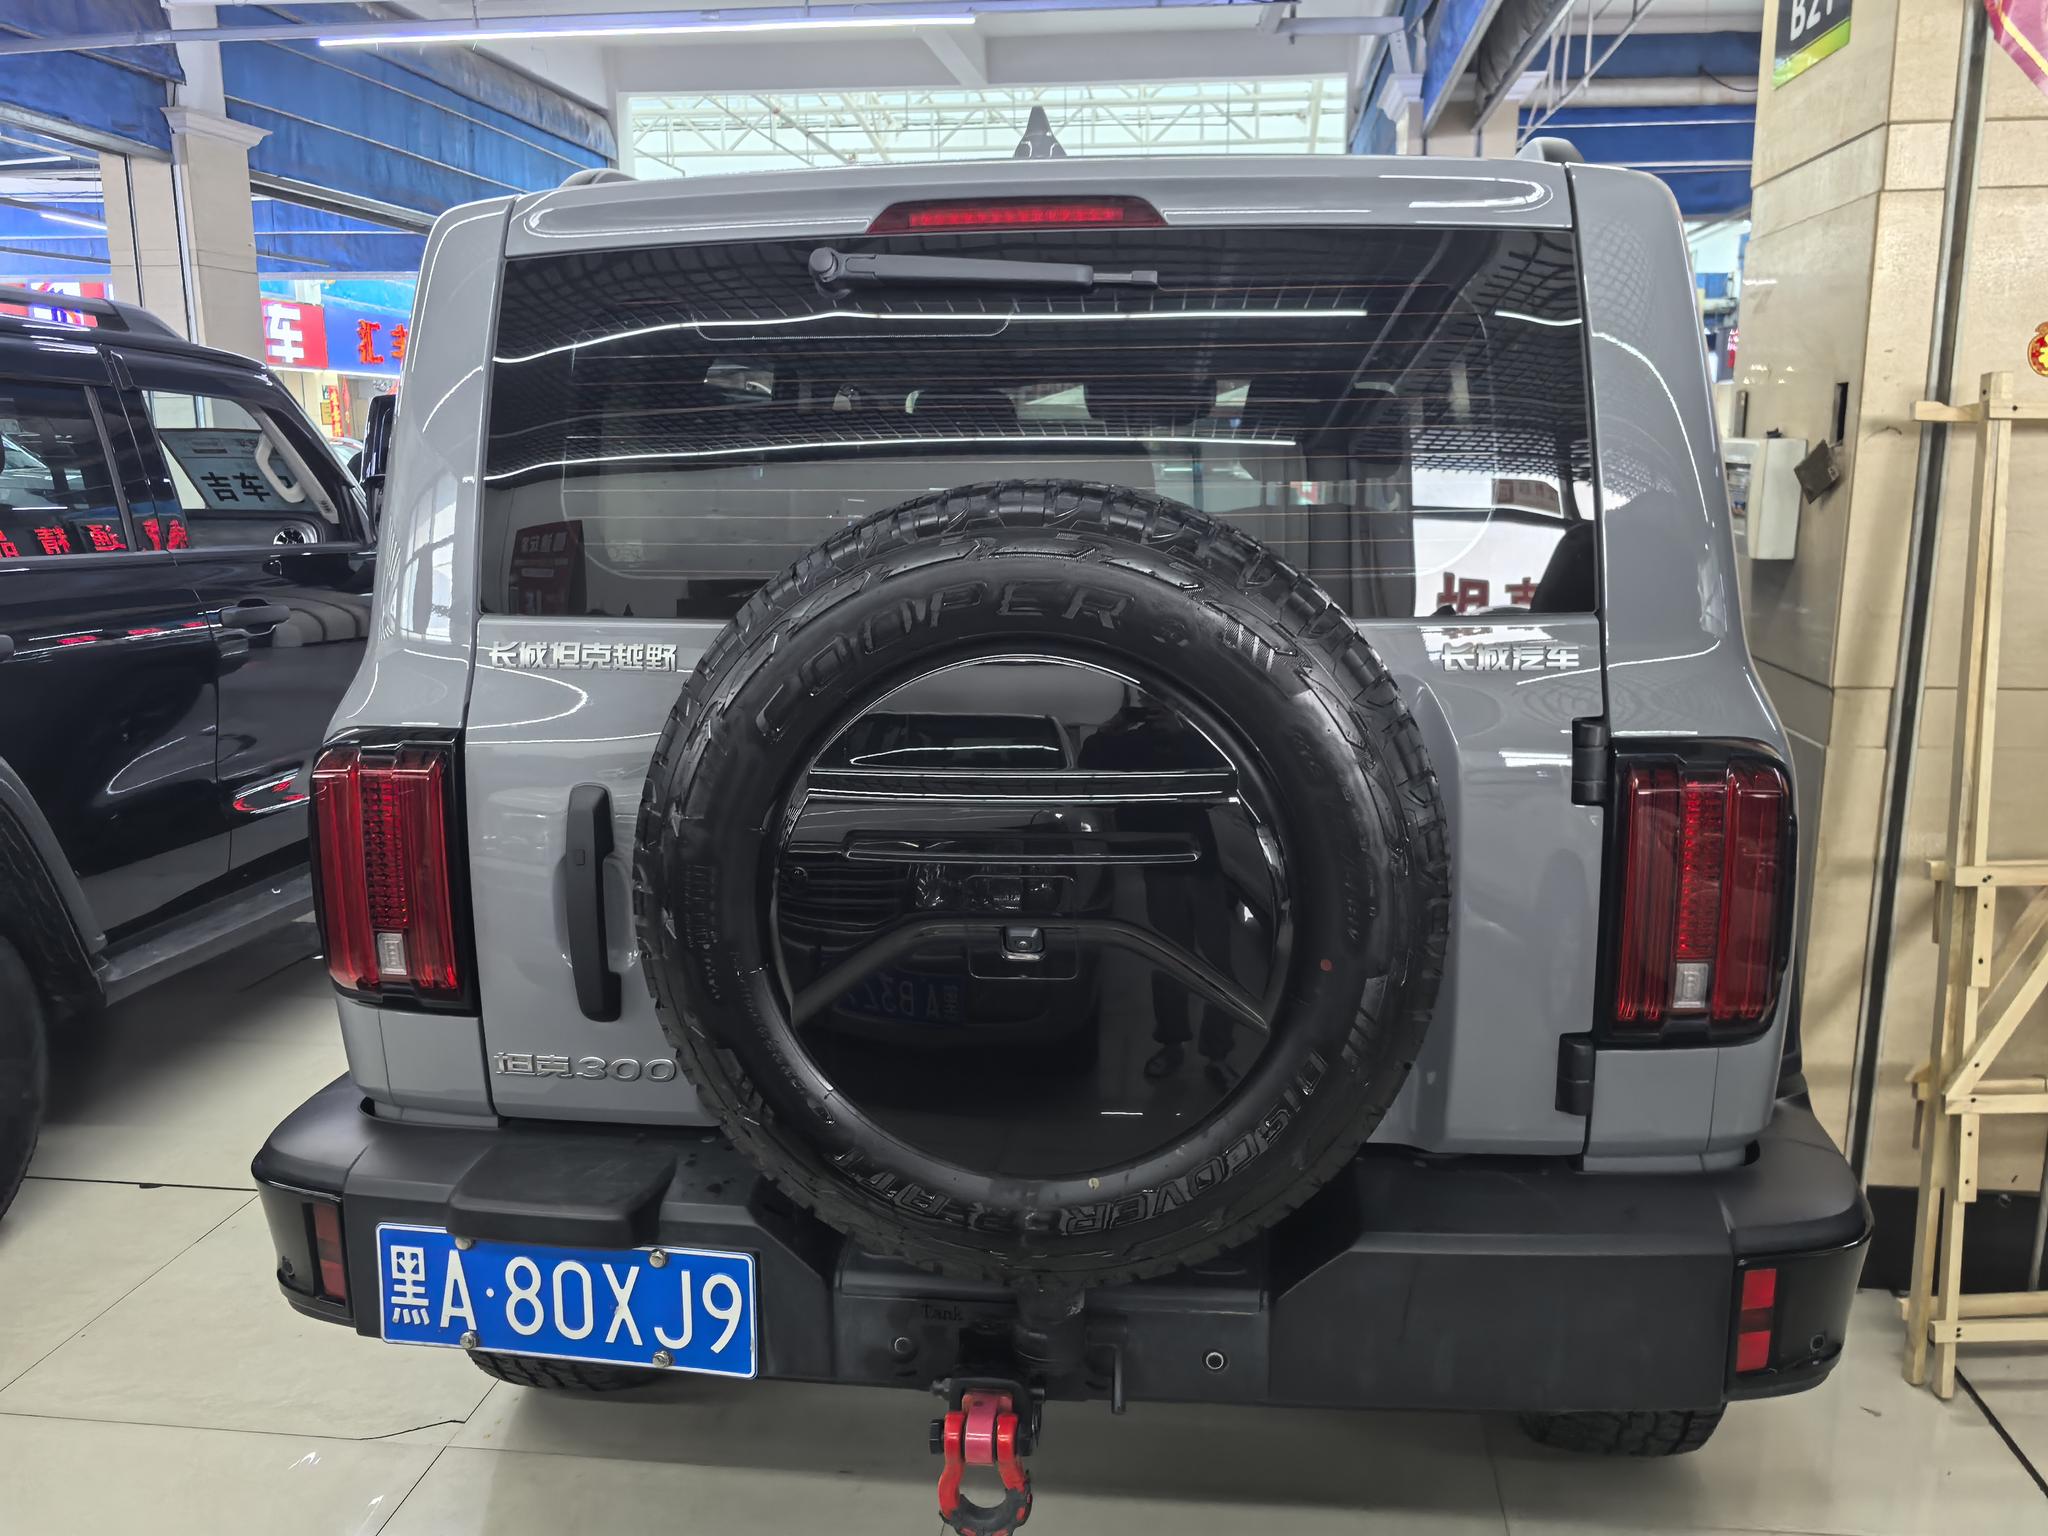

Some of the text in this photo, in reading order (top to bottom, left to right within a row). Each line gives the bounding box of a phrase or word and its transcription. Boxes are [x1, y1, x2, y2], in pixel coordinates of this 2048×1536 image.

[267, 303, 304, 364] 车
[488, 640, 678, 673] 长城坦克越野
[1440, 641, 1580, 672] 长城汽车
